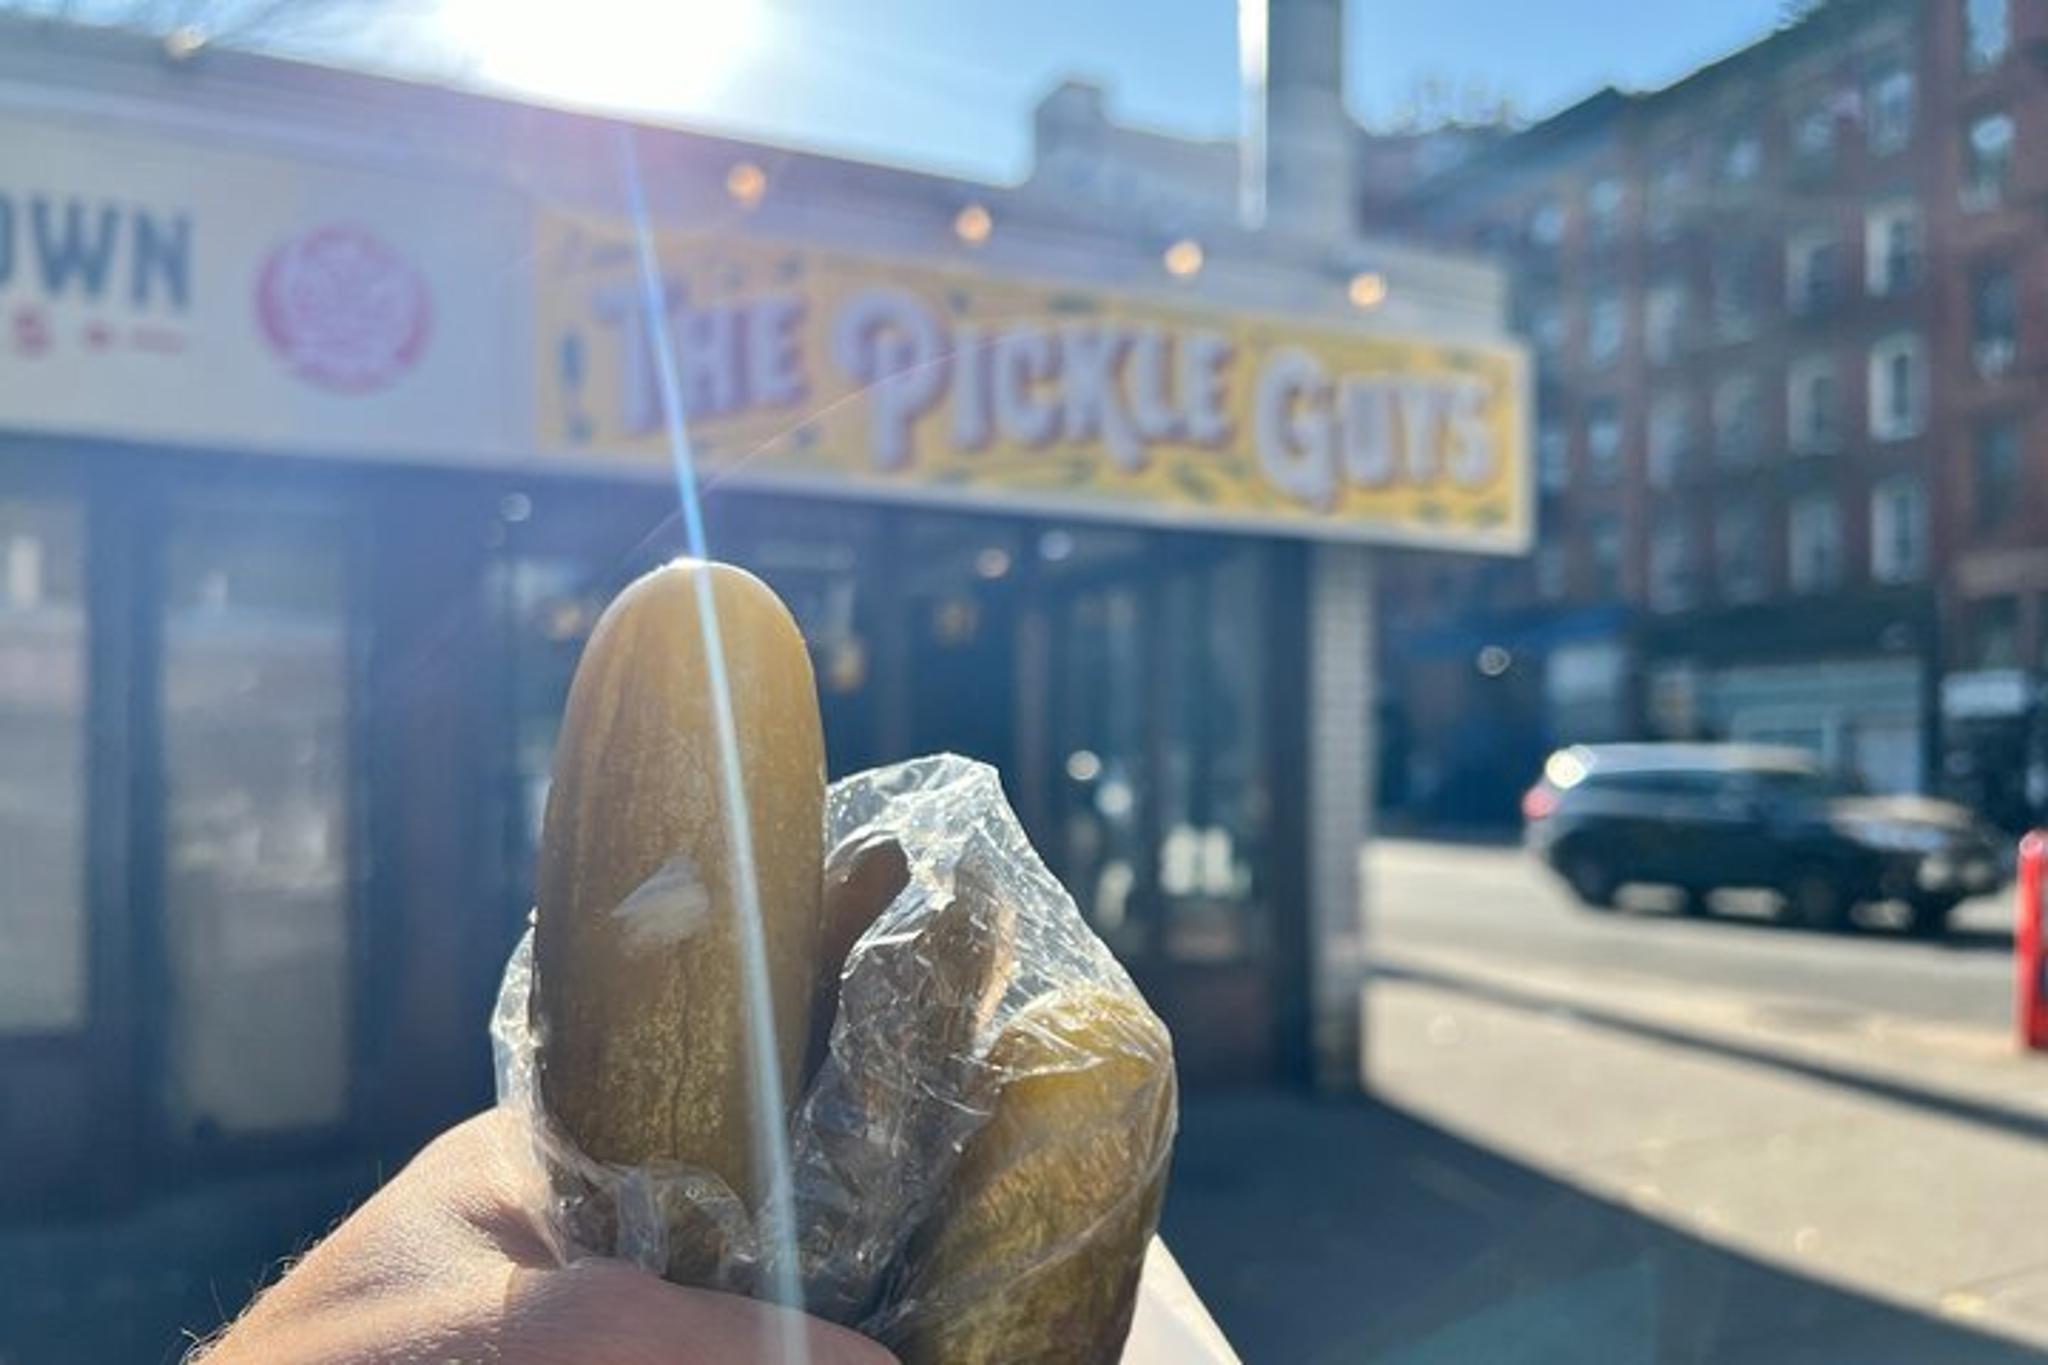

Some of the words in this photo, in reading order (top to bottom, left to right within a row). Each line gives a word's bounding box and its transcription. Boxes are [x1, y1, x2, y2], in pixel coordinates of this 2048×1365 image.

[0, 190, 194, 312] WN
[592, 274, 810, 434] THE
[832, 284, 1236, 474] PICKLE
[1254, 346, 1496, 512] GUYS
